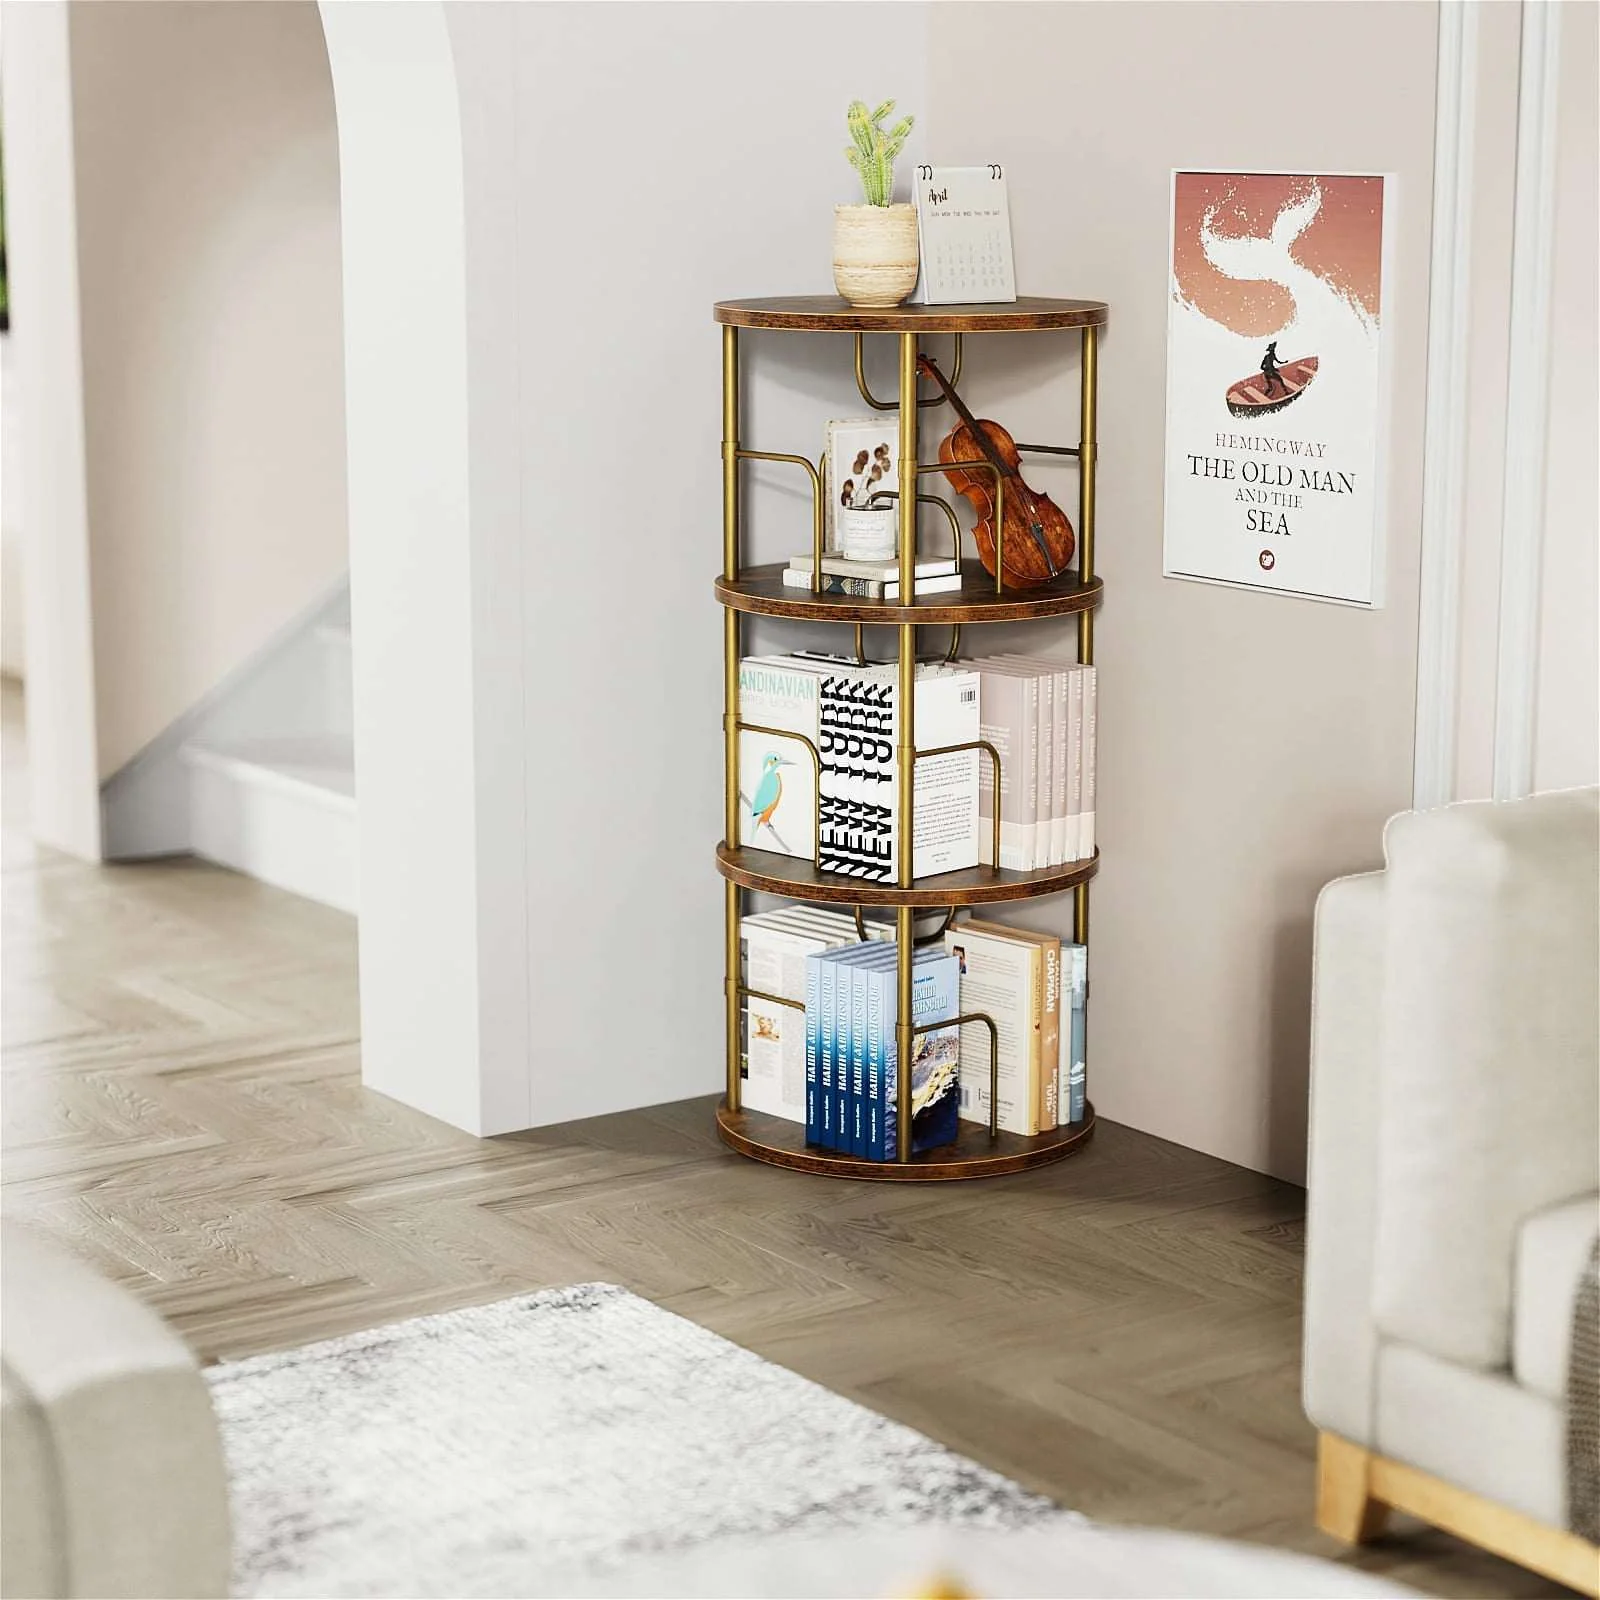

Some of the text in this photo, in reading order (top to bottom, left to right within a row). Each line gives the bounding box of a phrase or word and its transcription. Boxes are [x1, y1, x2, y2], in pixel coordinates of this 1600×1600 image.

[929, 188, 948, 205] April
[1216, 432, 1327, 458] HEMINGWAY
[1188, 454, 1356, 494] THE OLD MAN
[1235, 488, 1302, 508] AND THE
[1246, 508, 1291, 536] SEA
[741, 671, 813, 700] ANDINAVIAN
[820, 677, 834, 870] NEW YORK
[835, 679, 849, 873] NEW YORK
[849, 681, 863, 876] NEW YORK
[863, 683, 877, 880] NEW YORK
[877, 685, 892, 882] NEW YORK
[1046, 950, 1055, 1012] CHAPMAN
[823, 1050, 831, 1086] НАШИ
[838, 1054, 846, 1090] НАШИ
[854, 1058, 862, 1095] НАШИ
[869, 1063, 877, 1099] НАШИ
